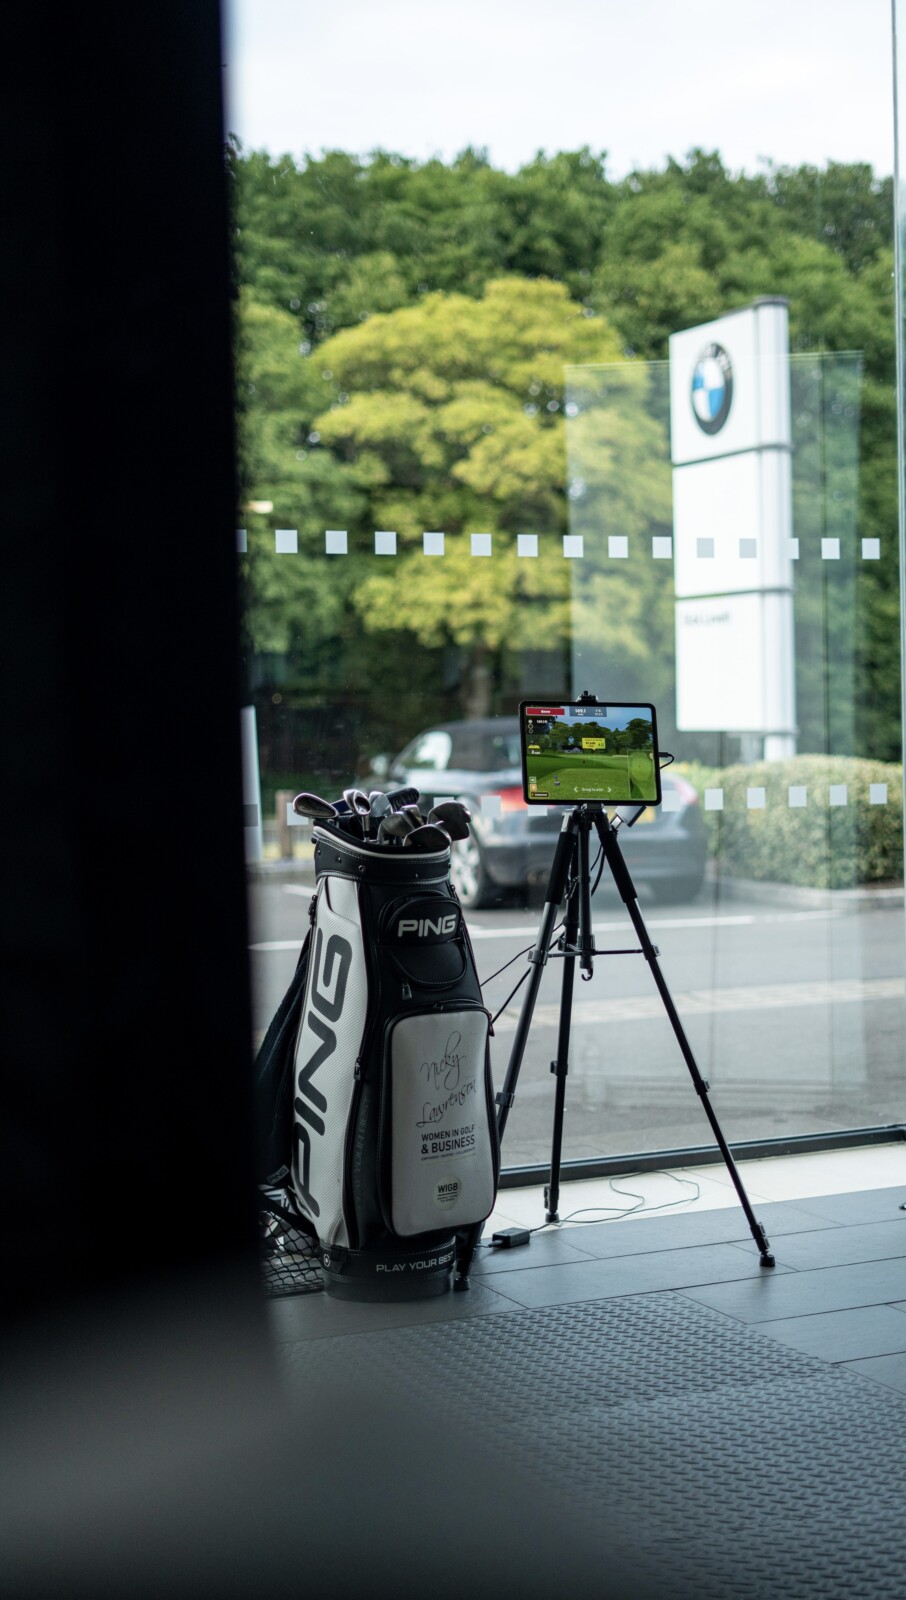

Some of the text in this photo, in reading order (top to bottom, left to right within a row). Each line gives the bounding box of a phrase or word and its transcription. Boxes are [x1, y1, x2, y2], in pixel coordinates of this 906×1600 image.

[397, 914, 457, 938] PING
[291, 927, 353, 1218] PING
[421, 1124, 476, 1142] WOMEN IN GOLF
[421, 1134, 475, 1155] & BUSINESS
[437, 1182, 458, 1193] WIGB
[375, 1263, 406, 1273] PLAY
[408, 1258, 438, 1271] YOUR
